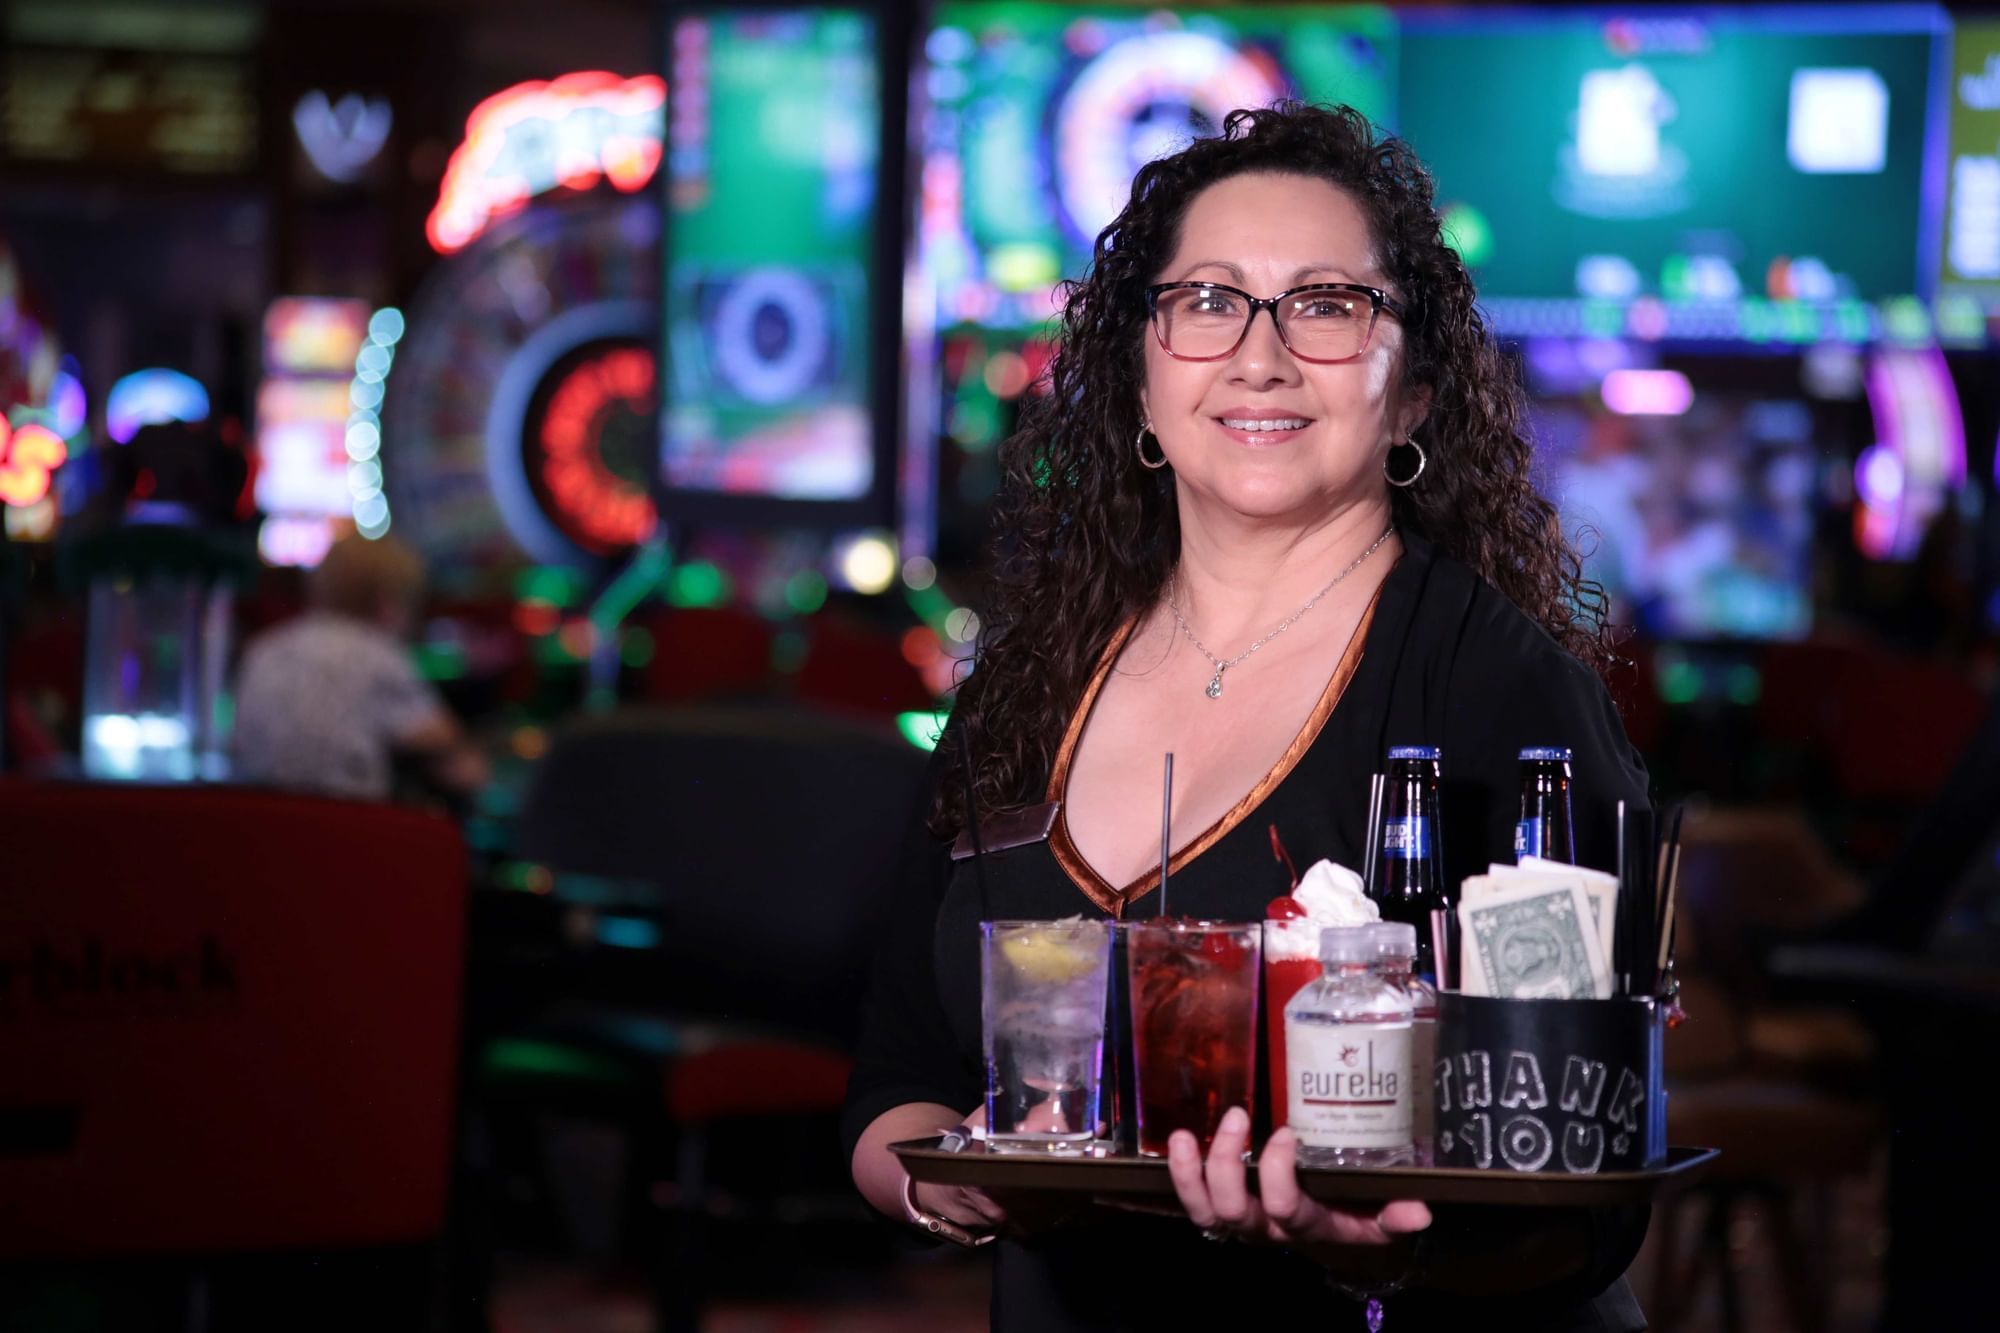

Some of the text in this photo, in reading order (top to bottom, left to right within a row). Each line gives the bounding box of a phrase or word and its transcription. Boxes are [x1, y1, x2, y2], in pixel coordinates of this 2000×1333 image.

[1302, 1040, 1398, 1097] eureka
[1435, 1050, 1644, 1132] THANK
[1459, 1112, 1604, 1174] YOU
